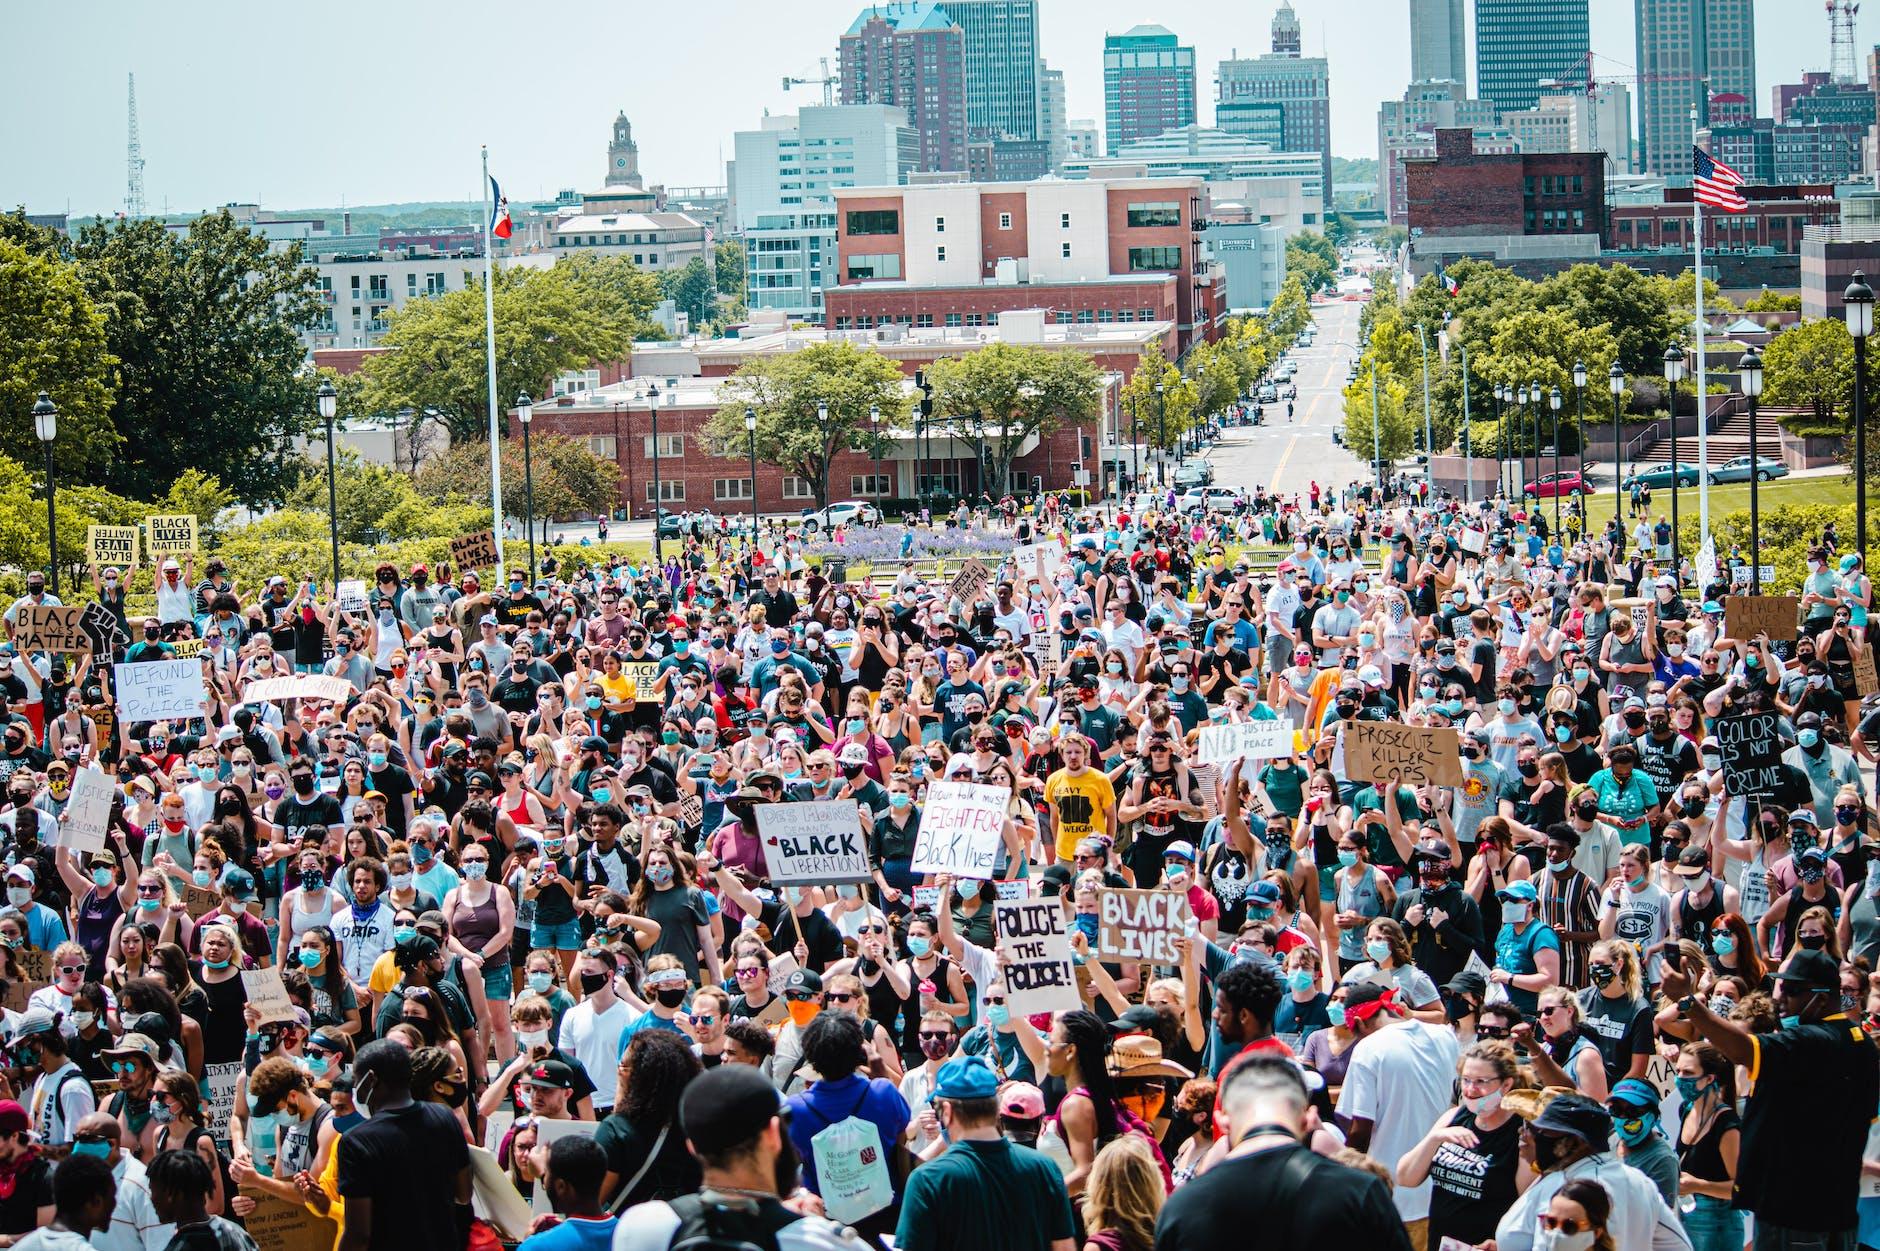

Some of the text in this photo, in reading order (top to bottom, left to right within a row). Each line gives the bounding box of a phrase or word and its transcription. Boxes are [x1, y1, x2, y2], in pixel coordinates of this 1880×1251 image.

[153, 518, 190, 529] BLACK
[95, 528, 134, 538] MATTER
[155, 529, 189, 539] LIVES
[95, 540, 133, 549] LIVES
[152, 541, 191, 551] MATTER
[451, 533, 489, 552] BLACK
[95, 551, 133, 561] BLACK
[456, 544, 489, 563] LIVES
[459, 553, 501, 572] MATTER
[1742, 598, 1785, 614] BLACK
[18, 608, 77, 628] BLAC
[1738, 614, 1780, 626] LIVES
[16, 634, 88, 650] MATTER
[175, 642, 201, 655] BLAC
[93, 653, 112, 664] BLM
[124, 663, 194, 686] DEFUND
[624, 665, 657, 676] LACK
[145, 685, 173, 698] THE
[128, 700, 194, 717] POLICE
[1717, 716, 1776, 744] COLOR
[1203, 720, 1286, 758] NO JUSTICE
[1243, 738, 1274, 749] PEACE
[1357, 724, 1443, 754] PROSECUTE
[1372, 748, 1435, 765] KILLER
[1718, 739, 1772, 762] IS NOT
[1372, 764, 1425, 781] COPS
[1724, 762, 1735, 775] A
[1726, 765, 1784, 795] CRIME
[79, 784, 113, 803] USTICE
[983, 792, 1006, 805] must
[1053, 786, 1082, 795] HEAVY
[77, 800, 89, 818] 4
[762, 807, 797, 825] DES
[930, 806, 1002, 832] FIGHT FOR
[784, 825, 832, 834] DEMANDS
[1063, 825, 1093, 833] WEIGHT
[780, 833, 859, 857] BLACK
[965, 834, 993, 868] lives
[777, 852, 868, 876] LIBERATION!
[188, 889, 221, 906] BLAC
[1102, 892, 1185, 928] BLACK
[1637, 901, 1660, 915] PROUD
[998, 905, 1065, 938] POLICE
[341, 926, 380, 938] DRIP
[1012, 942, 1046, 958] THE
[1101, 930, 1180, 964] LIVES
[20, 954, 44, 966] ACK
[1004, 961, 1071, 993] POLICE!
[1441, 1141, 1463, 1156] WHITE
[1432, 1146, 1489, 1177] EQUALS
[1446, 1169, 1484, 1188] CONSENT
[1455, 1186, 1482, 1200] MATTER
